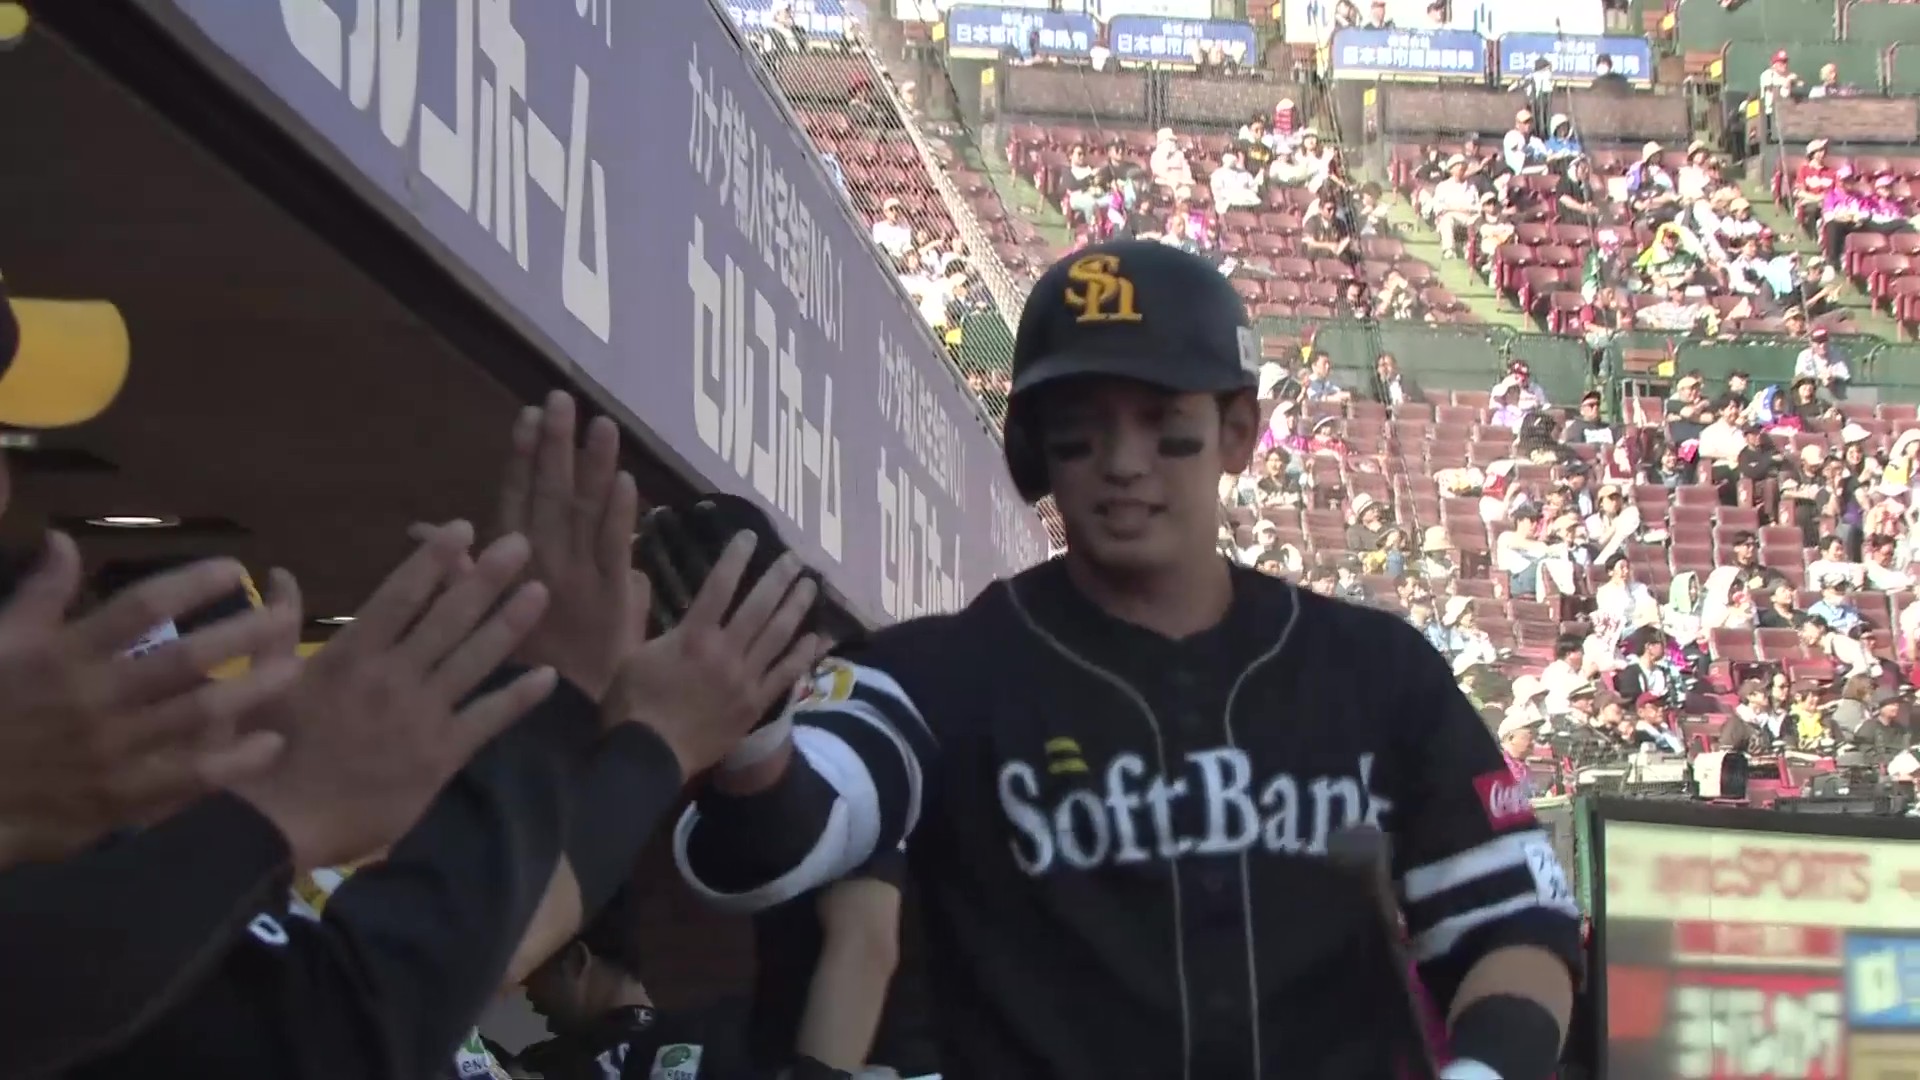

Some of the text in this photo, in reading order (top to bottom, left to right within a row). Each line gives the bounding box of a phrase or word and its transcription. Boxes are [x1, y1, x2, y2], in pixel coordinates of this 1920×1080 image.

[688, 214, 842, 563] セルコホーム
